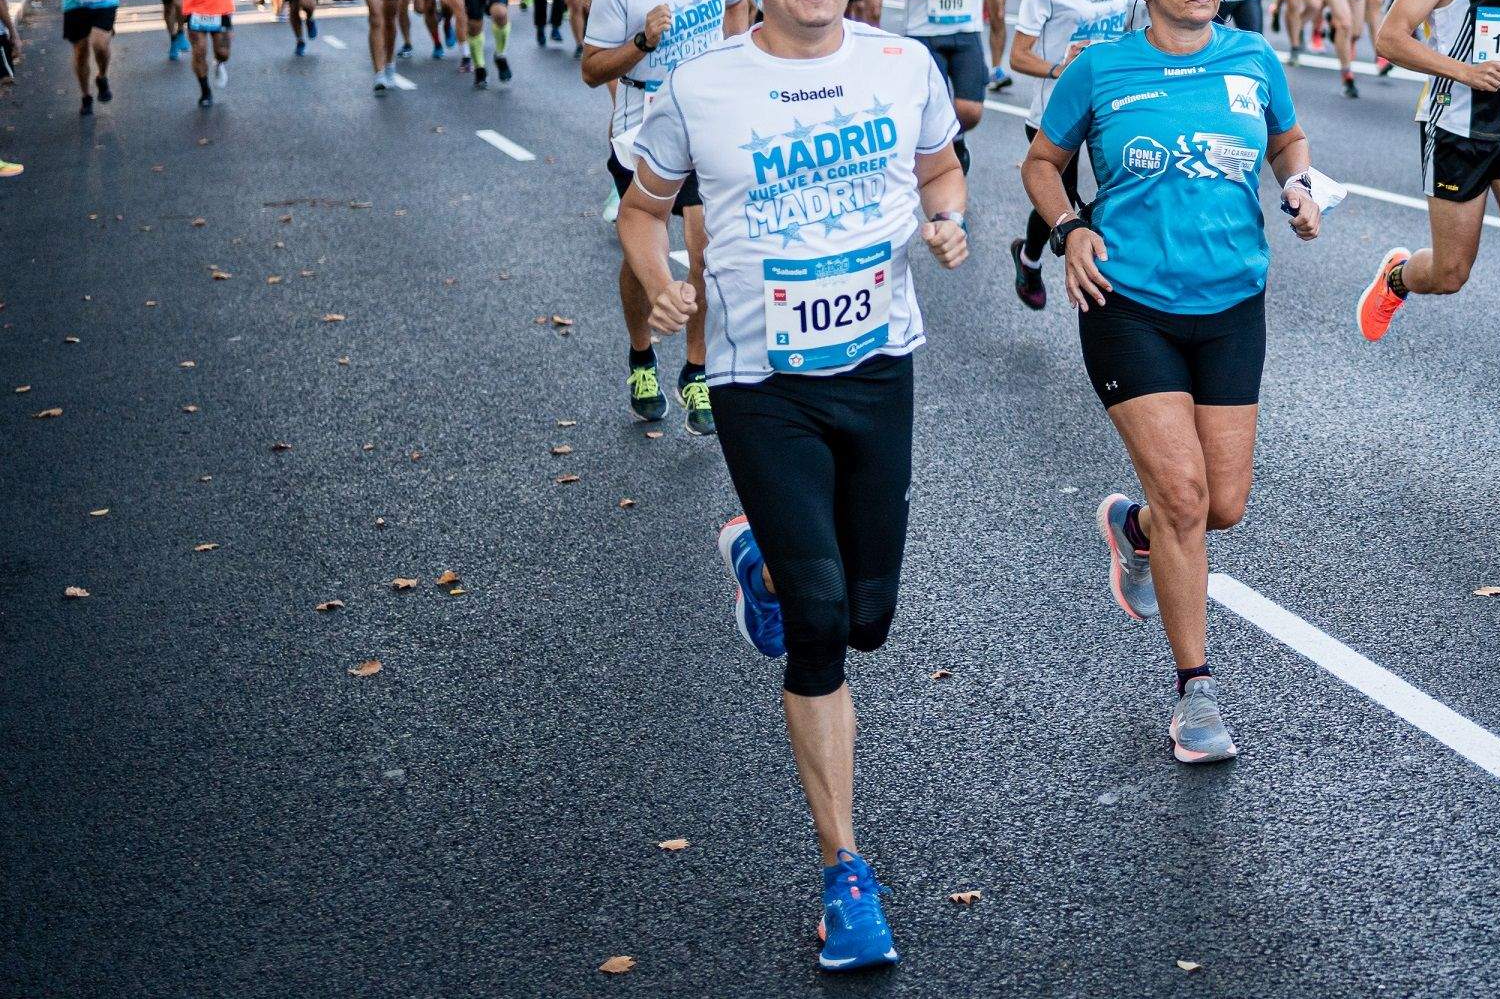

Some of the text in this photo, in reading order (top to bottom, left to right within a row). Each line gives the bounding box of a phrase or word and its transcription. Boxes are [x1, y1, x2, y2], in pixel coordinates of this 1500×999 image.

[939, 0, 963, 10] 1019
[780, 85, 844, 103] Sabadell
[752, 116, 898, 185] MADRID
[1129, 147, 1162, 161] PONLE
[1129, 157, 1161, 170] FRENO
[748, 157, 888, 201] VUELVE A CORRER
[744, 172, 887, 239] MADRID
[792, 288, 871, 334] 1023
[779, 334, 786, 344] 2
